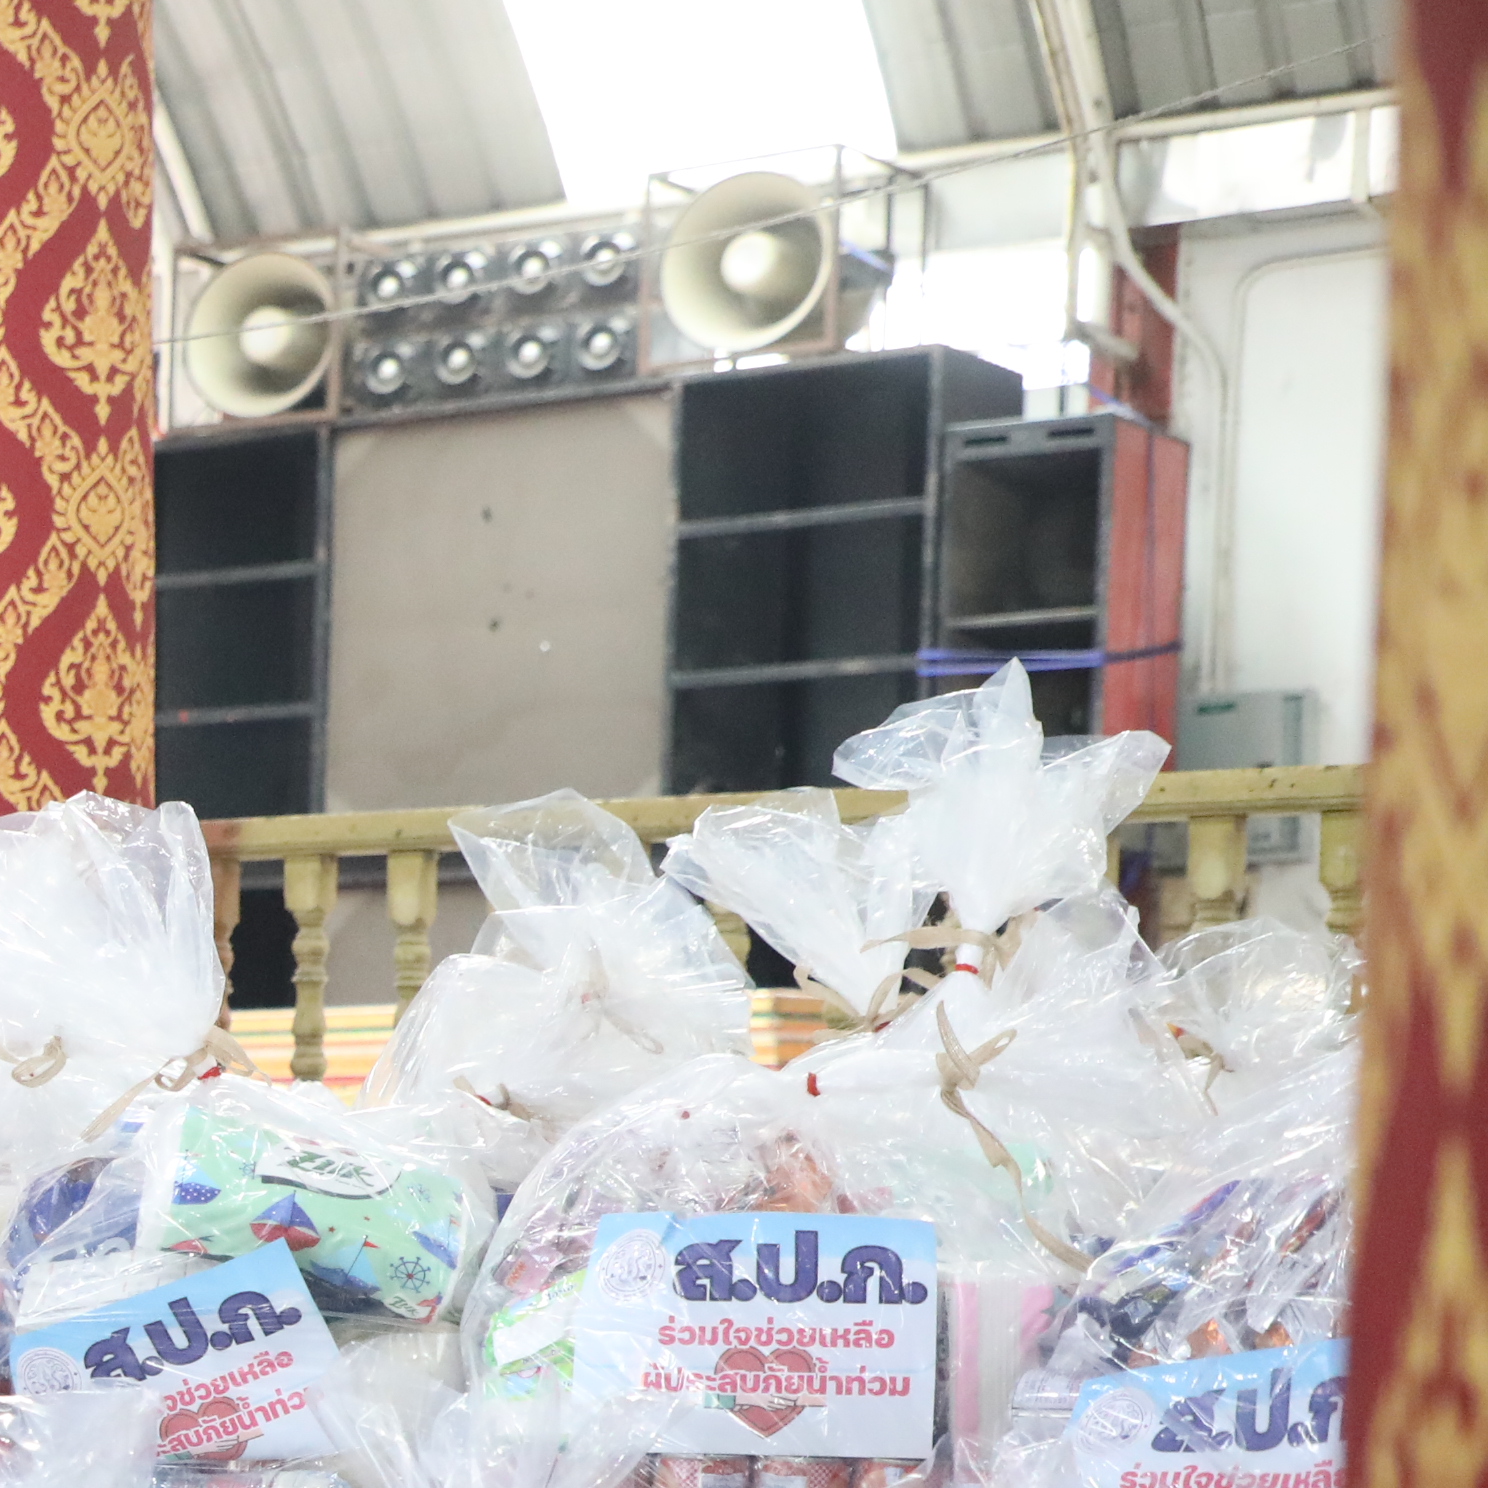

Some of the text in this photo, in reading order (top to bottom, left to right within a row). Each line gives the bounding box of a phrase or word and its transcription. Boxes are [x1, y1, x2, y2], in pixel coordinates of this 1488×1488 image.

[672, 1230, 929, 1305] ส.ป.ก.
[657, 1316, 896, 1349] ร่วมใจช่วยเหลือ
